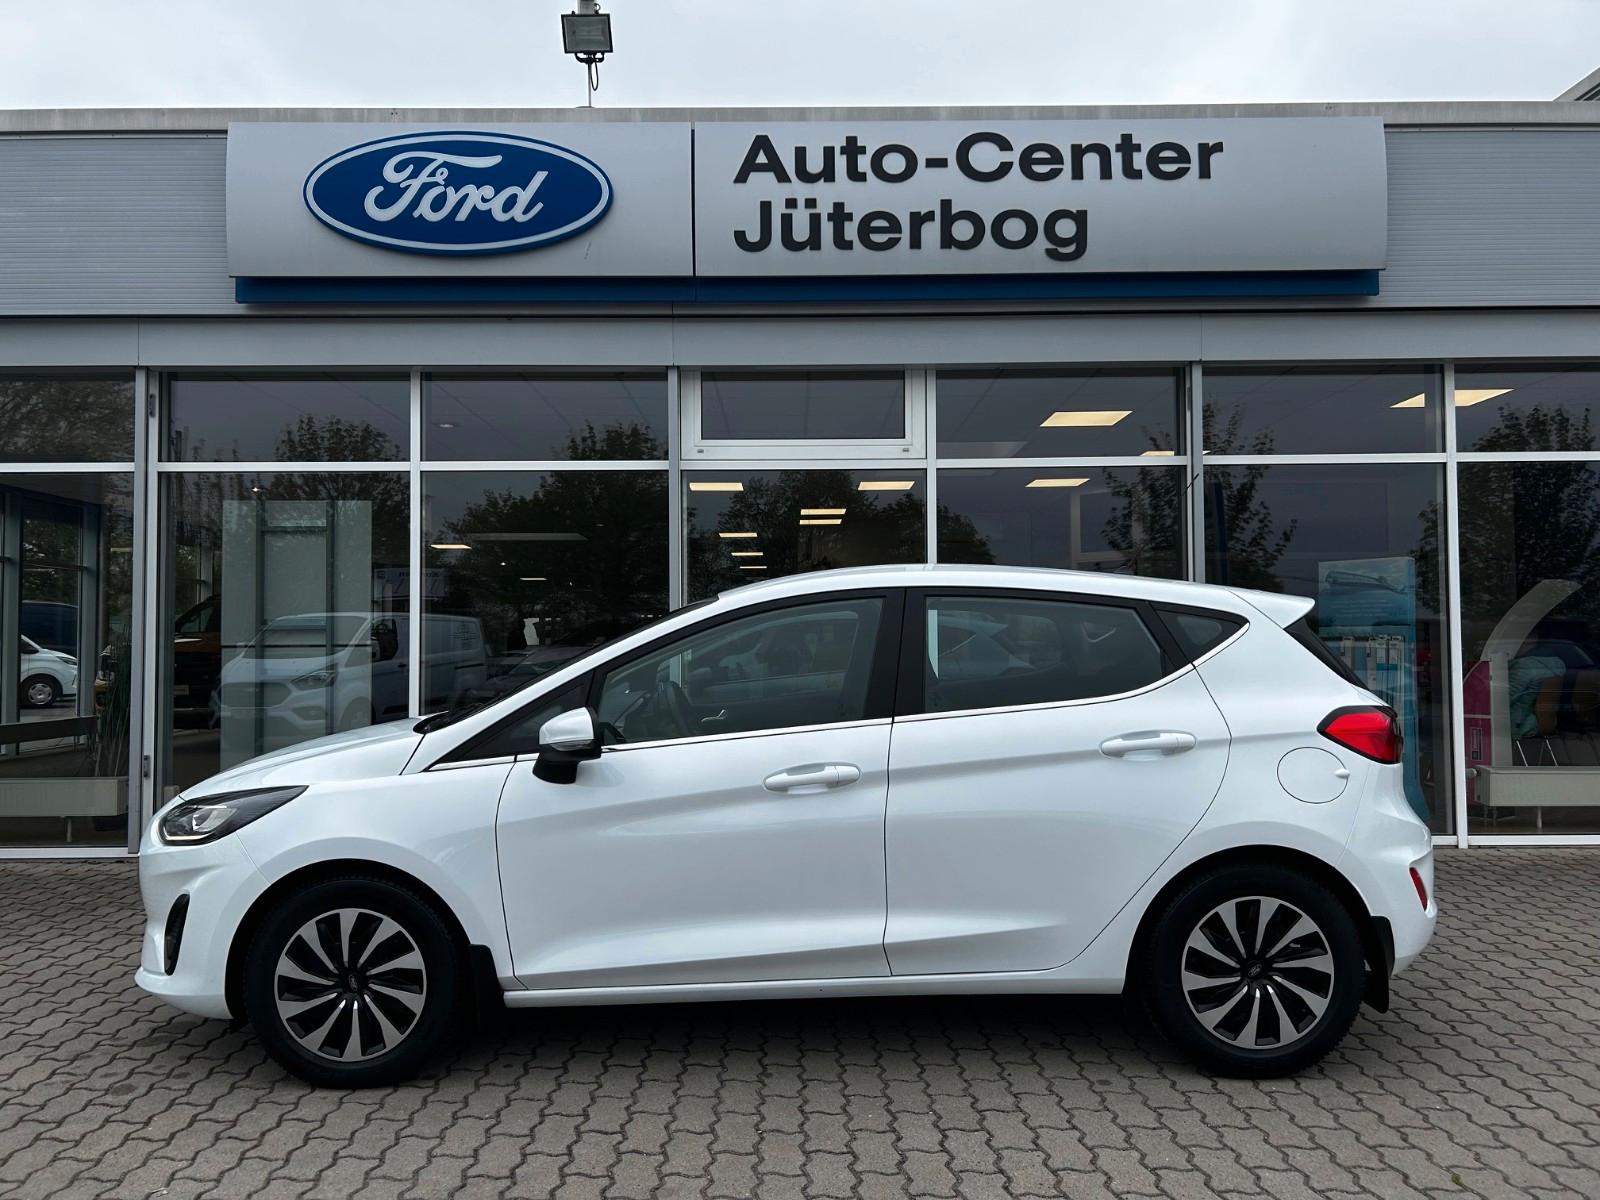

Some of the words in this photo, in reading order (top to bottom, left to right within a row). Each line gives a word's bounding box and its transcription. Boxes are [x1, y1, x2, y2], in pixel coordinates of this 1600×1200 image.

[364, 151, 548, 222] Ford
[733, 132, 1223, 183] Auto-Center
[734, 198, 1087, 262] Jüterbog
